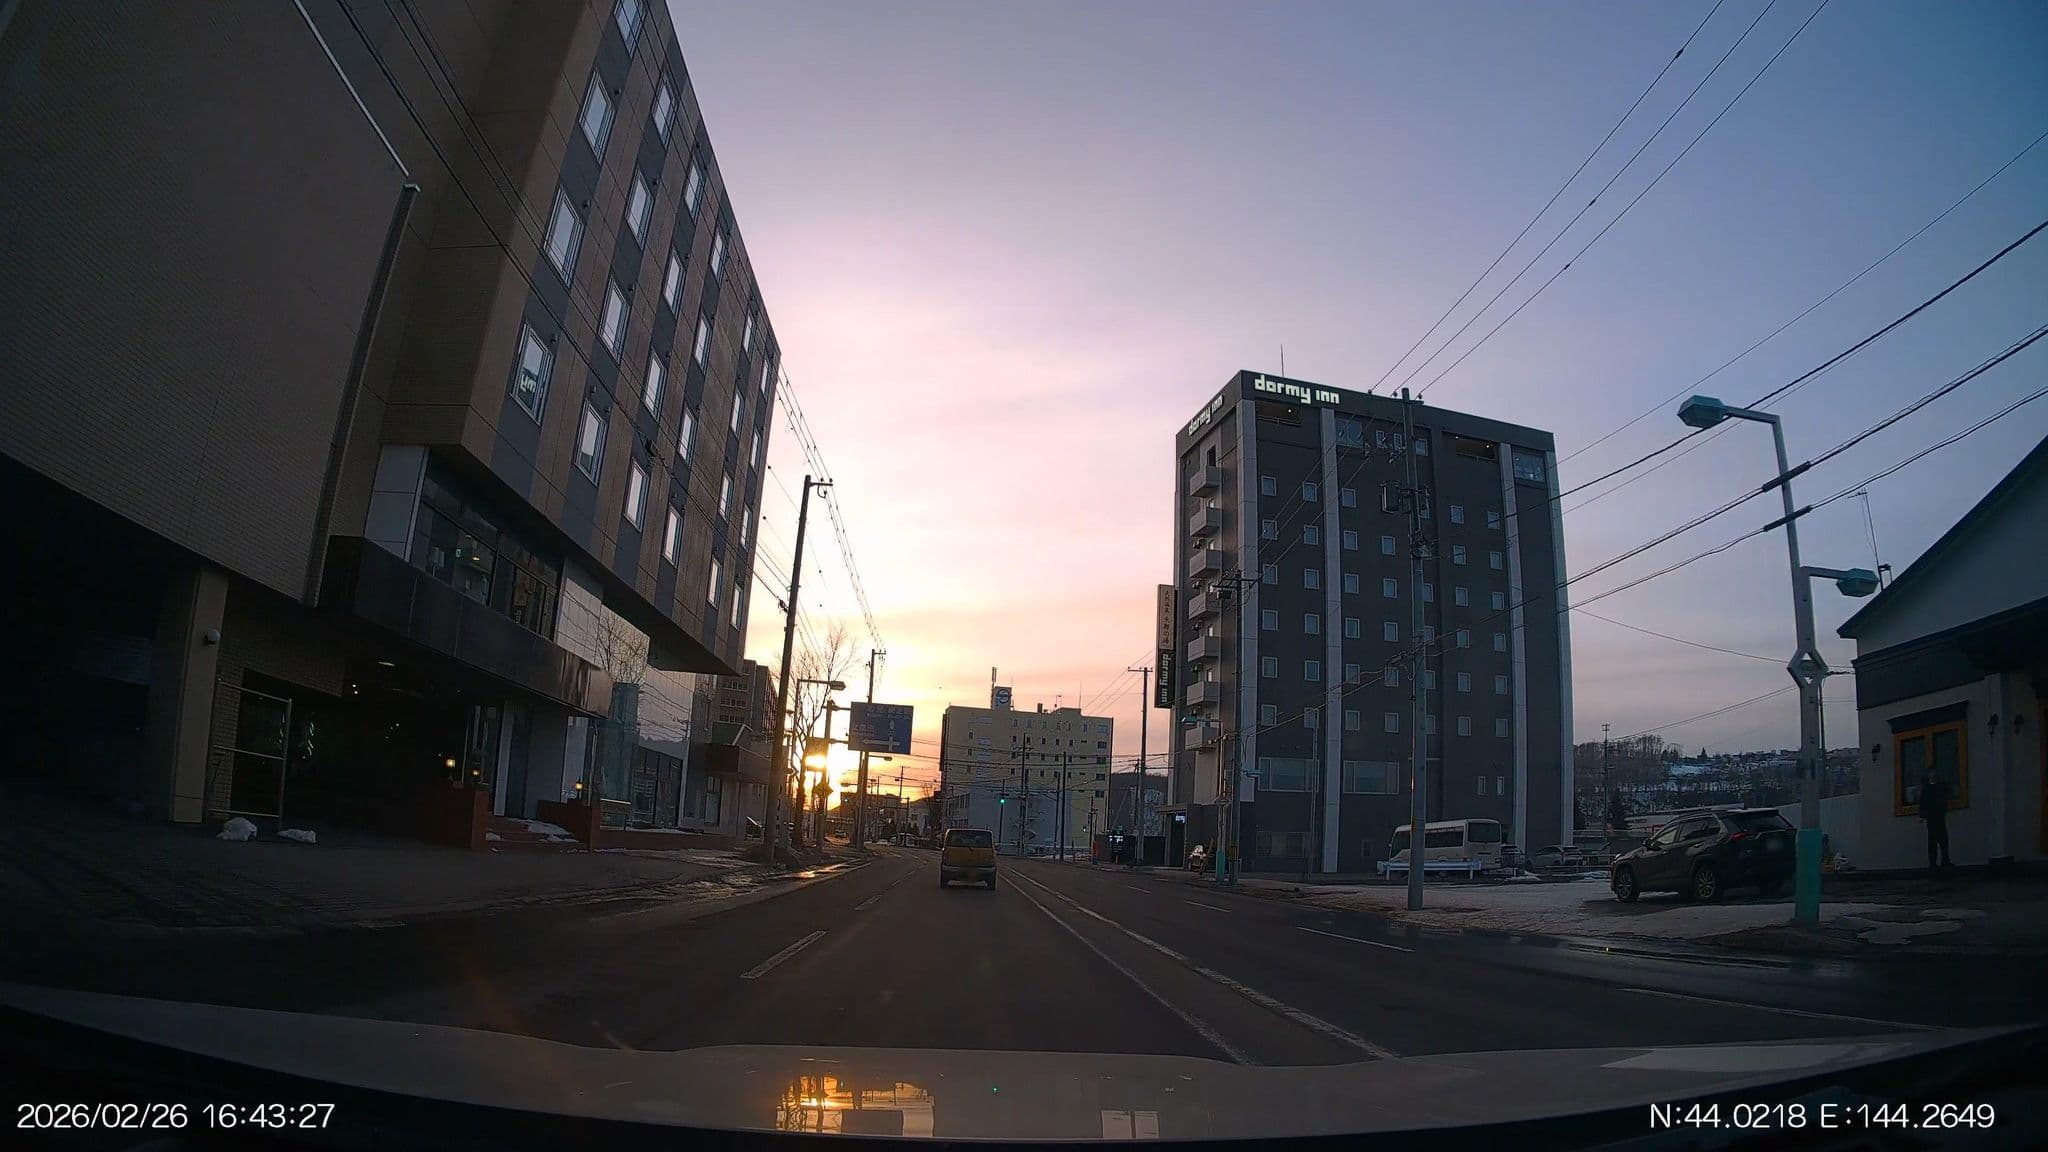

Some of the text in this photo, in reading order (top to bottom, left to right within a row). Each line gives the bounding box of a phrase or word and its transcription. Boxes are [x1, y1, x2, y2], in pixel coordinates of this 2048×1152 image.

[1255, 374, 1340, 404] dormy inn
[1188, 406, 1211, 436] dormy
[1160, 653, 1171, 703] dormy inn
